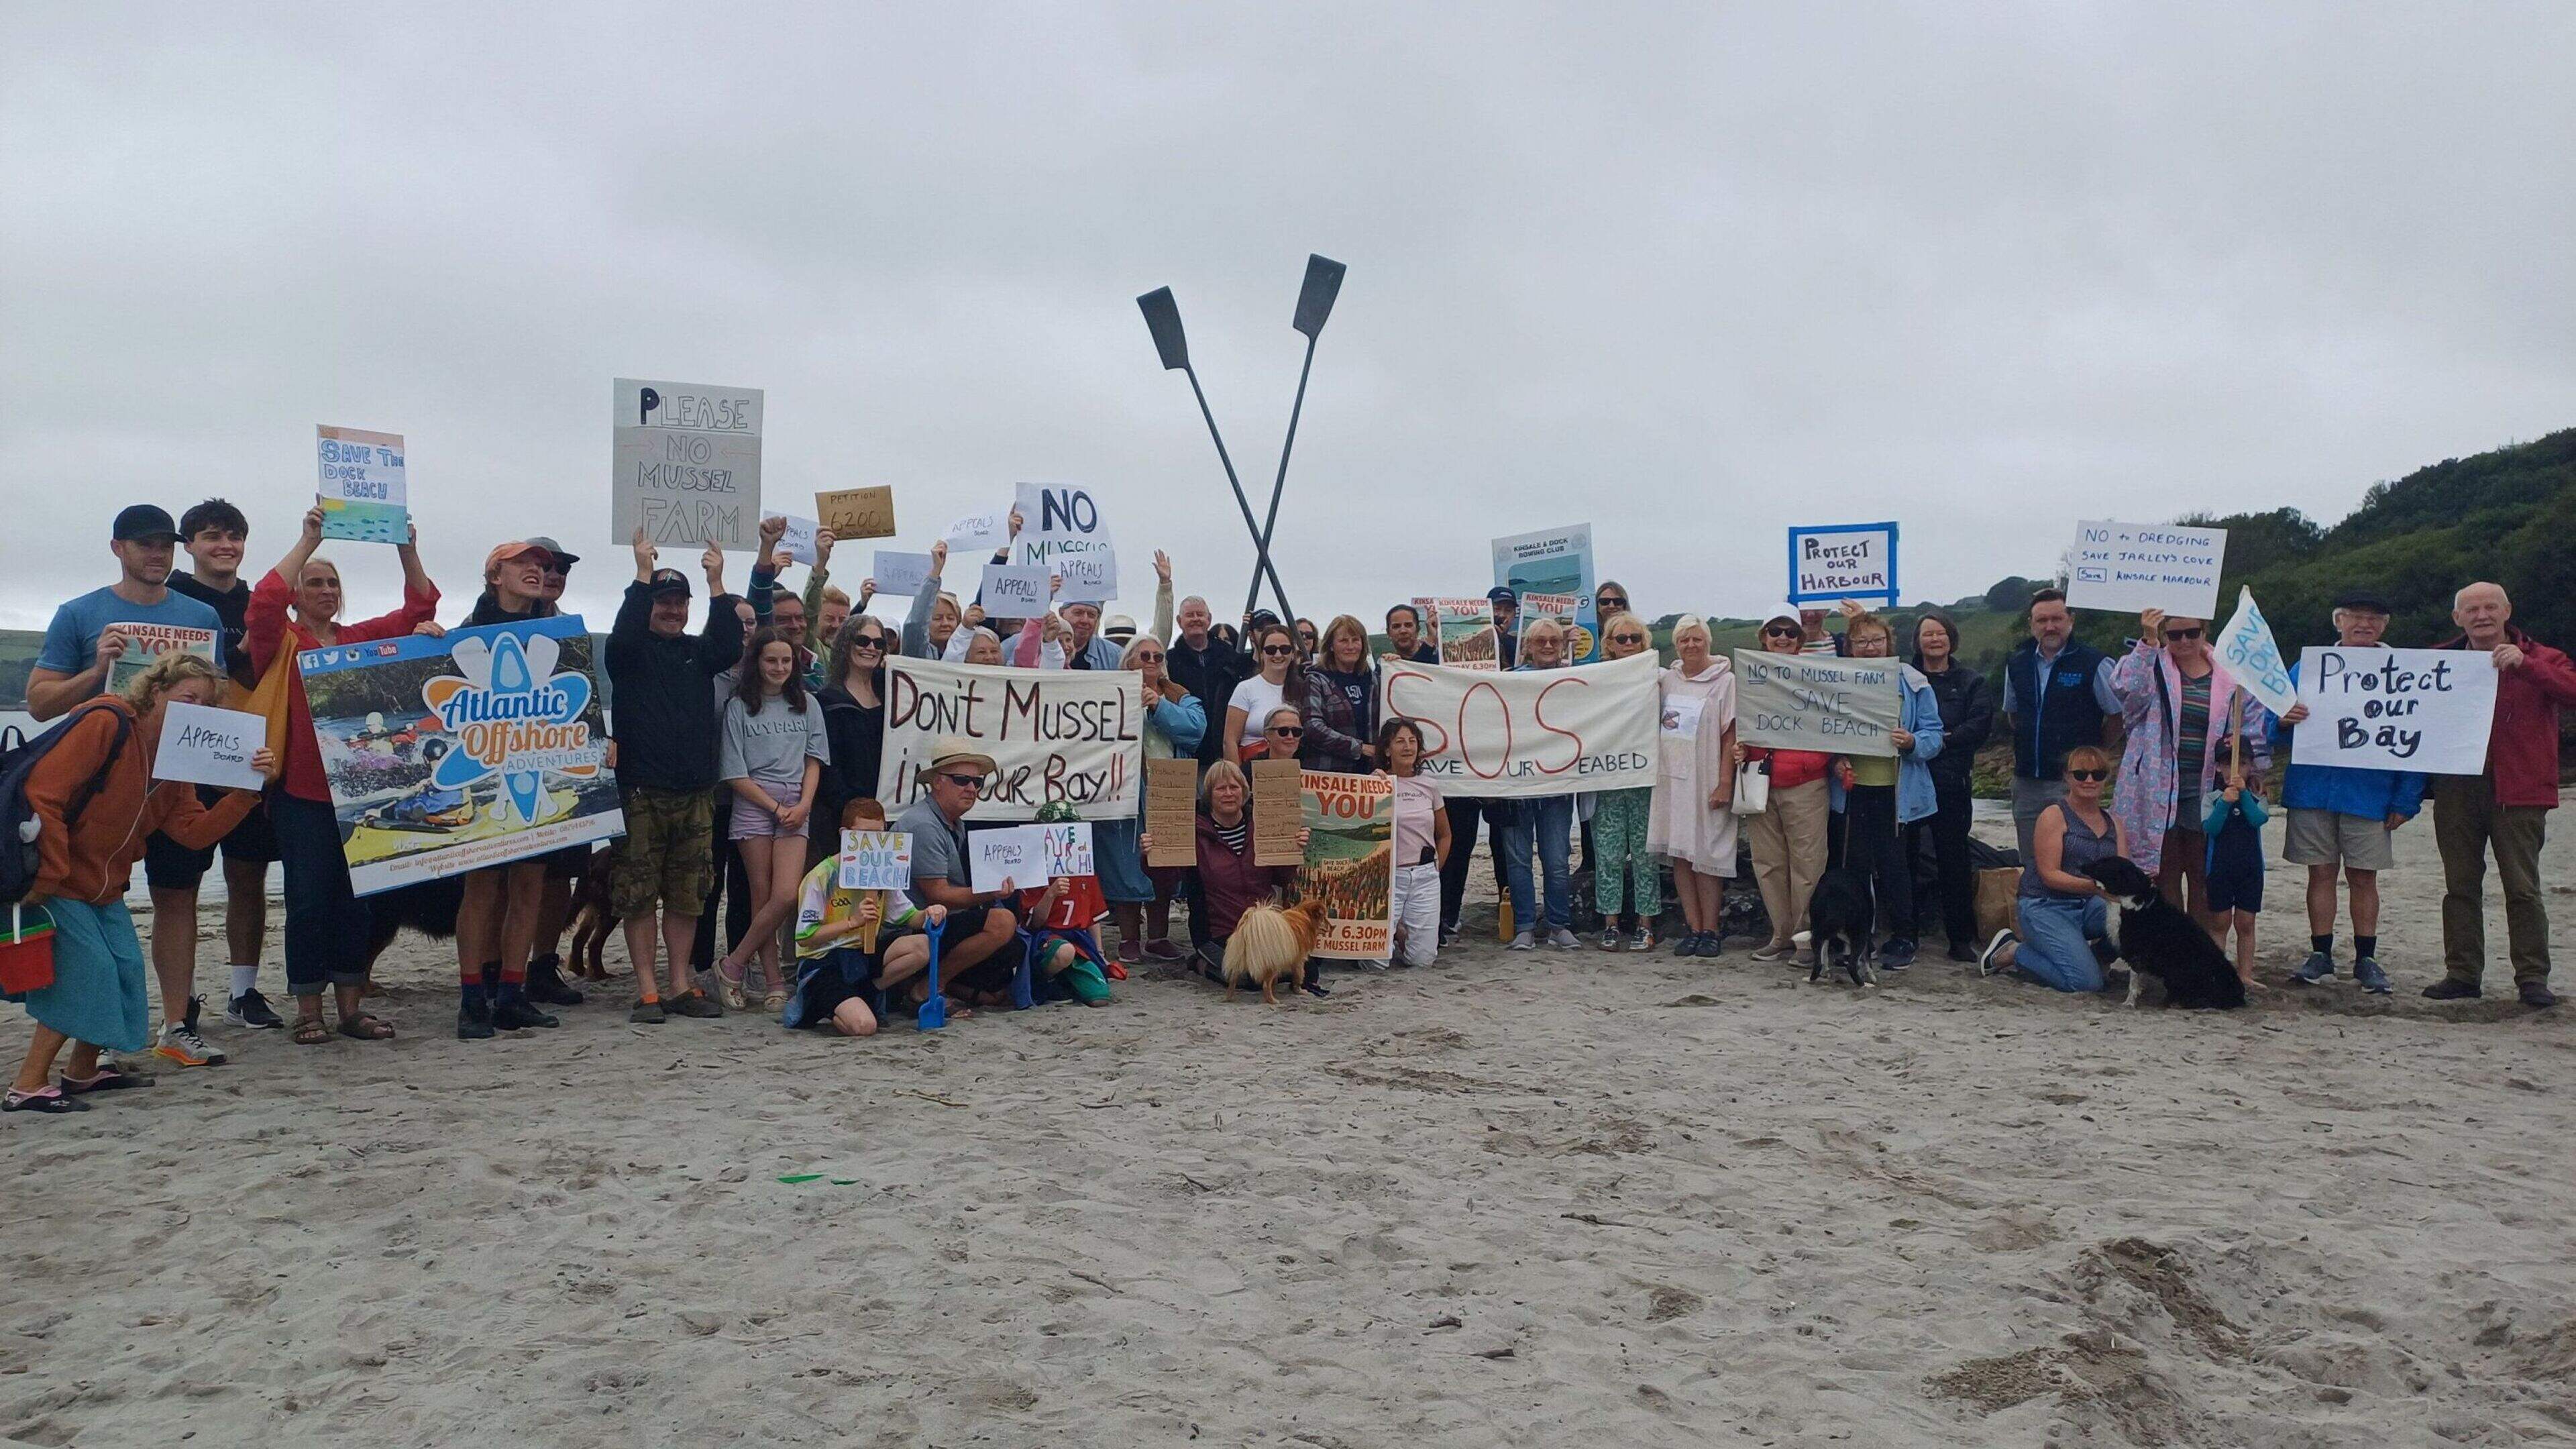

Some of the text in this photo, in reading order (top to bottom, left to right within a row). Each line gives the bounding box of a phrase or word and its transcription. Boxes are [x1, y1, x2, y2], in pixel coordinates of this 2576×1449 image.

[641, 387, 749, 429] PLEASE
[321, 440, 371, 464] SAVE
[667, 435, 711, 464] NO
[324, 464, 366, 480] DOCK
[638, 462, 735, 493] MUSSEL
[343, 479, 387, 500] BEACH
[830, 491, 875, 504] PETITION
[642, 498, 739, 543] FARM
[1041, 488, 1097, 534] NO
[830, 511, 881, 531] 6200
[952, 516, 995, 533] APPEALS
[1513, 542, 1542, 552] KINSALE
[1549, 537, 1568, 546] DOCK
[2086, 529, 2109, 543] NO
[2139, 532, 2211, 547] DREDGING
[1519, 545, 1565, 558] ROWING CLUB
[1805, 538, 1870, 560] PROTECT
[2082, 551, 2110, 561] SAVE
[2183, 556, 2213, 566] COVE
[1061, 560, 1103, 579] APPEALS
[2116, 570, 2157, 582] KINSALE
[2163, 575, 2211, 586] HARBOUR
[995, 578, 1038, 596] APPEALS
[1801, 572, 1886, 590] HARBOUR
[1413, 596, 1434, 605] KINSA
[1526, 594, 1554, 602] KINSALE
[1451, 606, 1479, 616] YOU
[1536, 602, 1564, 615] YOU
[174, 628, 211, 642] NEEDS
[136, 637, 188, 656] YOU
[1748, 663, 1886, 685] NO TO MUSSEL FARM
[2318, 652, 2453, 694] Protect
[441, 686, 567, 729] Atlantic
[1788, 688, 1852, 716] SAVE
[2363, 697, 2419, 719] our
[1756, 714, 1878, 737] DOCK BEACH
[177, 724, 239, 751] APPEALS
[462, 722, 586, 765] Offshore
[2338, 717, 2421, 759] Bay
[213, 751, 244, 763] BOARD
[507, 751, 598, 772] ADVENTURES
[1360, 779, 1393, 794] NEEDS
[1316, 791, 1375, 819] YOU
[847, 832, 904, 852] SAVE
[1044, 827, 1075, 843] AVE
[859, 851, 893, 867] OUR
[984, 844, 1022, 862] APPEALS
[1053, 853, 1091, 875] ACH!
[845, 865, 910, 888] BEACH!
[1062, 900, 1075, 926] 7
[1342, 926, 1387, 940] 6.30PM
[1324, 941, 1359, 952] MUSSEL
[1362, 941, 1385, 952] FARM
